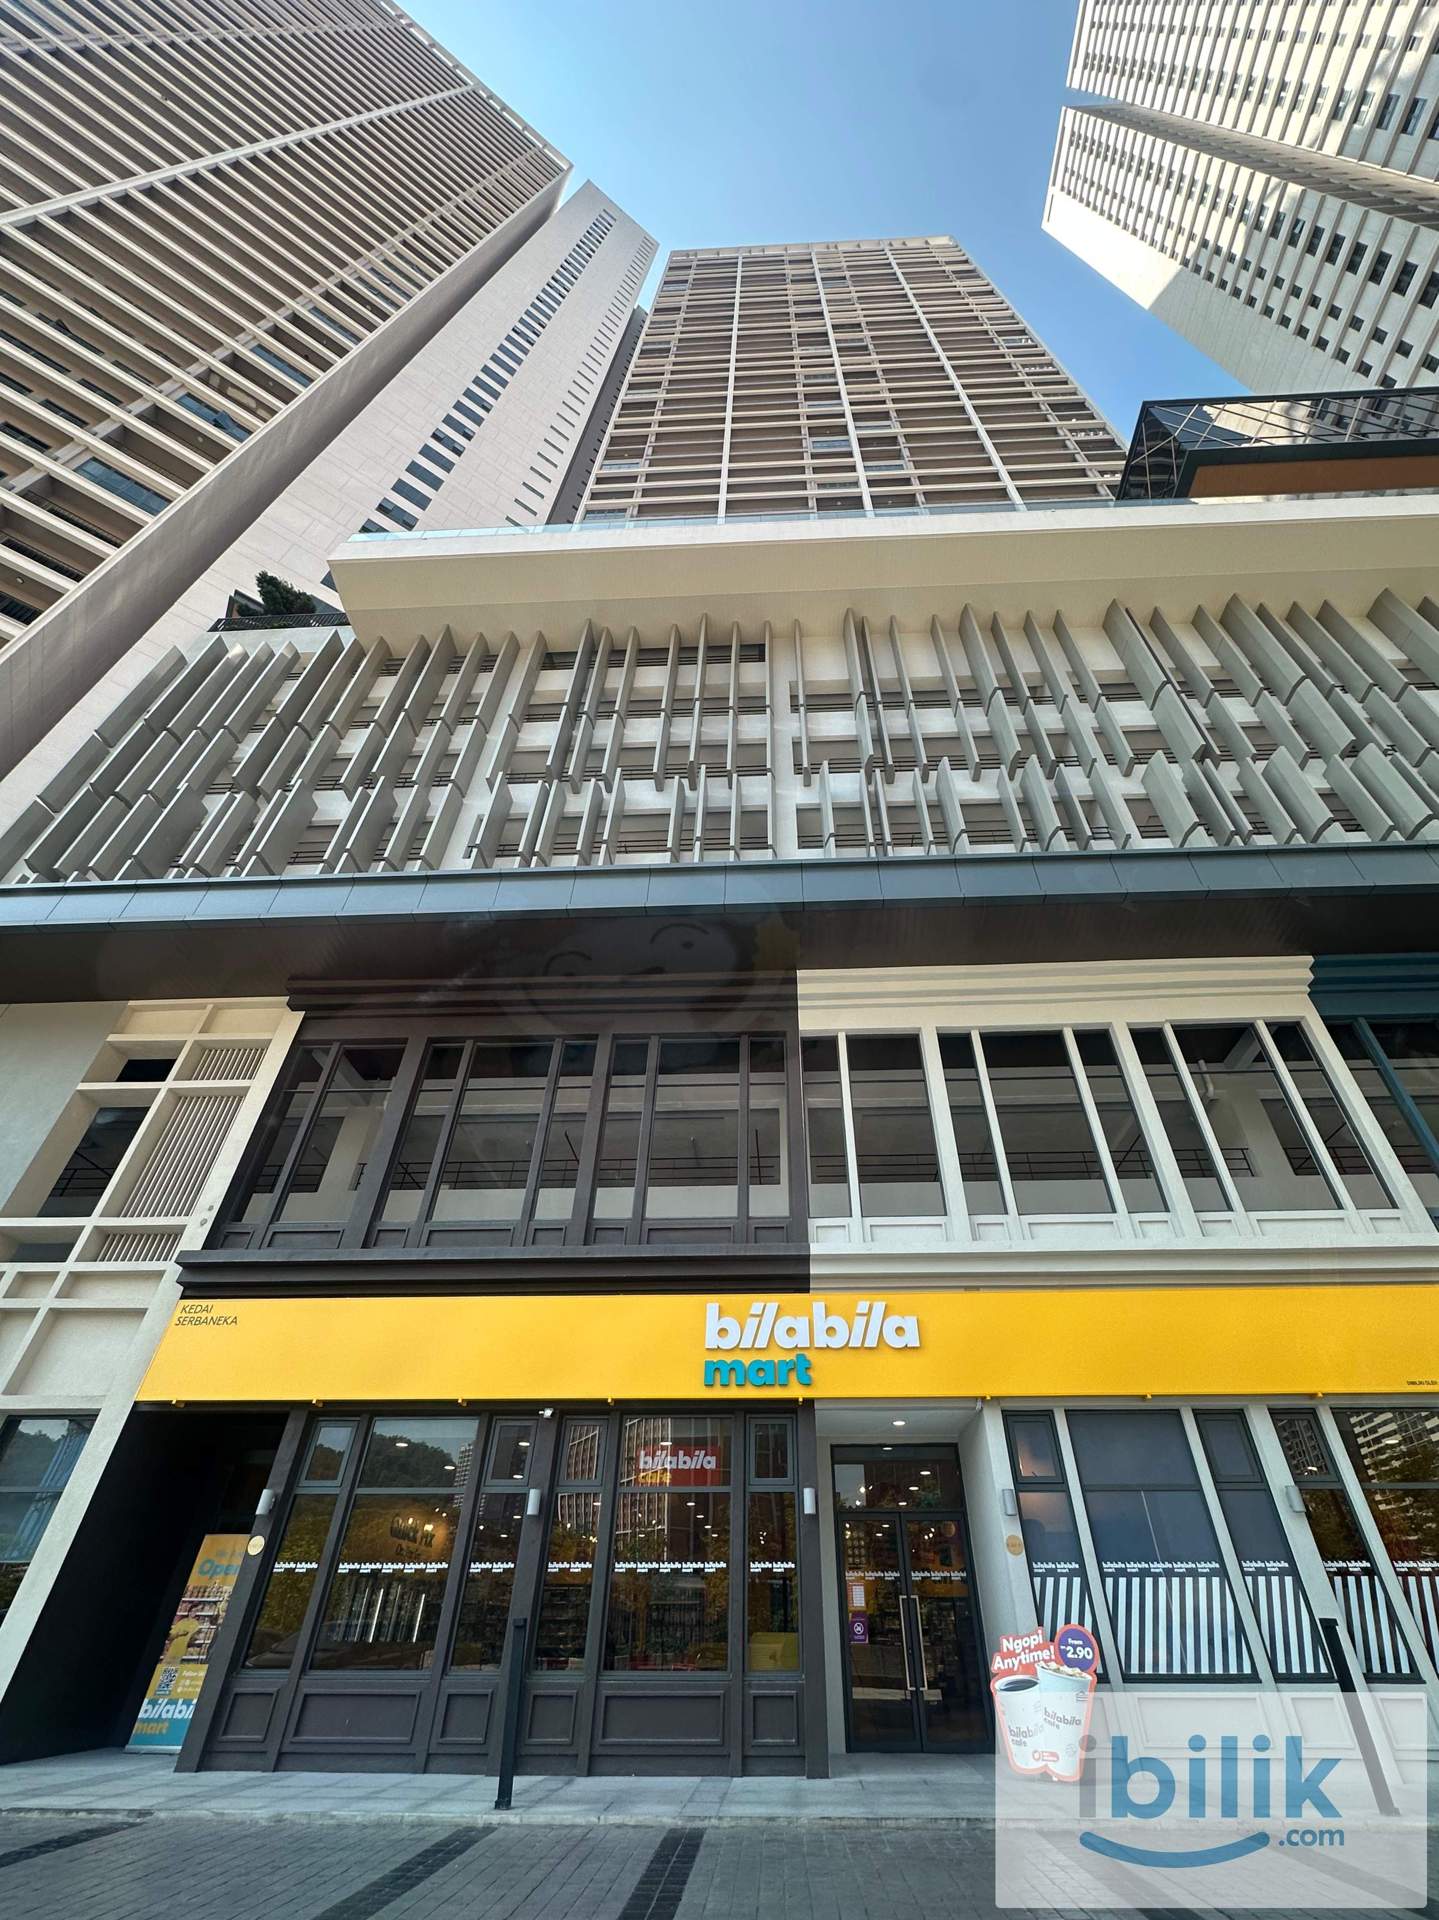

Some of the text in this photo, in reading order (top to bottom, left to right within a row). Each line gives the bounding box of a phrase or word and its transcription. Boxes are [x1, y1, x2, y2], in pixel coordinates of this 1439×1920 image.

[180, 1304, 213, 1314] KEDAI
[175, 1316, 238, 1326] SERBANEKA
[705, 1301, 920, 1350] bilabila
[704, 1353, 812, 1386] mart
[639, 1450, 717, 1469] bilabila
[1002, 1629, 1043, 1653] Ngopi
[994, 1645, 1056, 1671] Anytime!
[1066, 1646, 1093, 1660] 2.90
